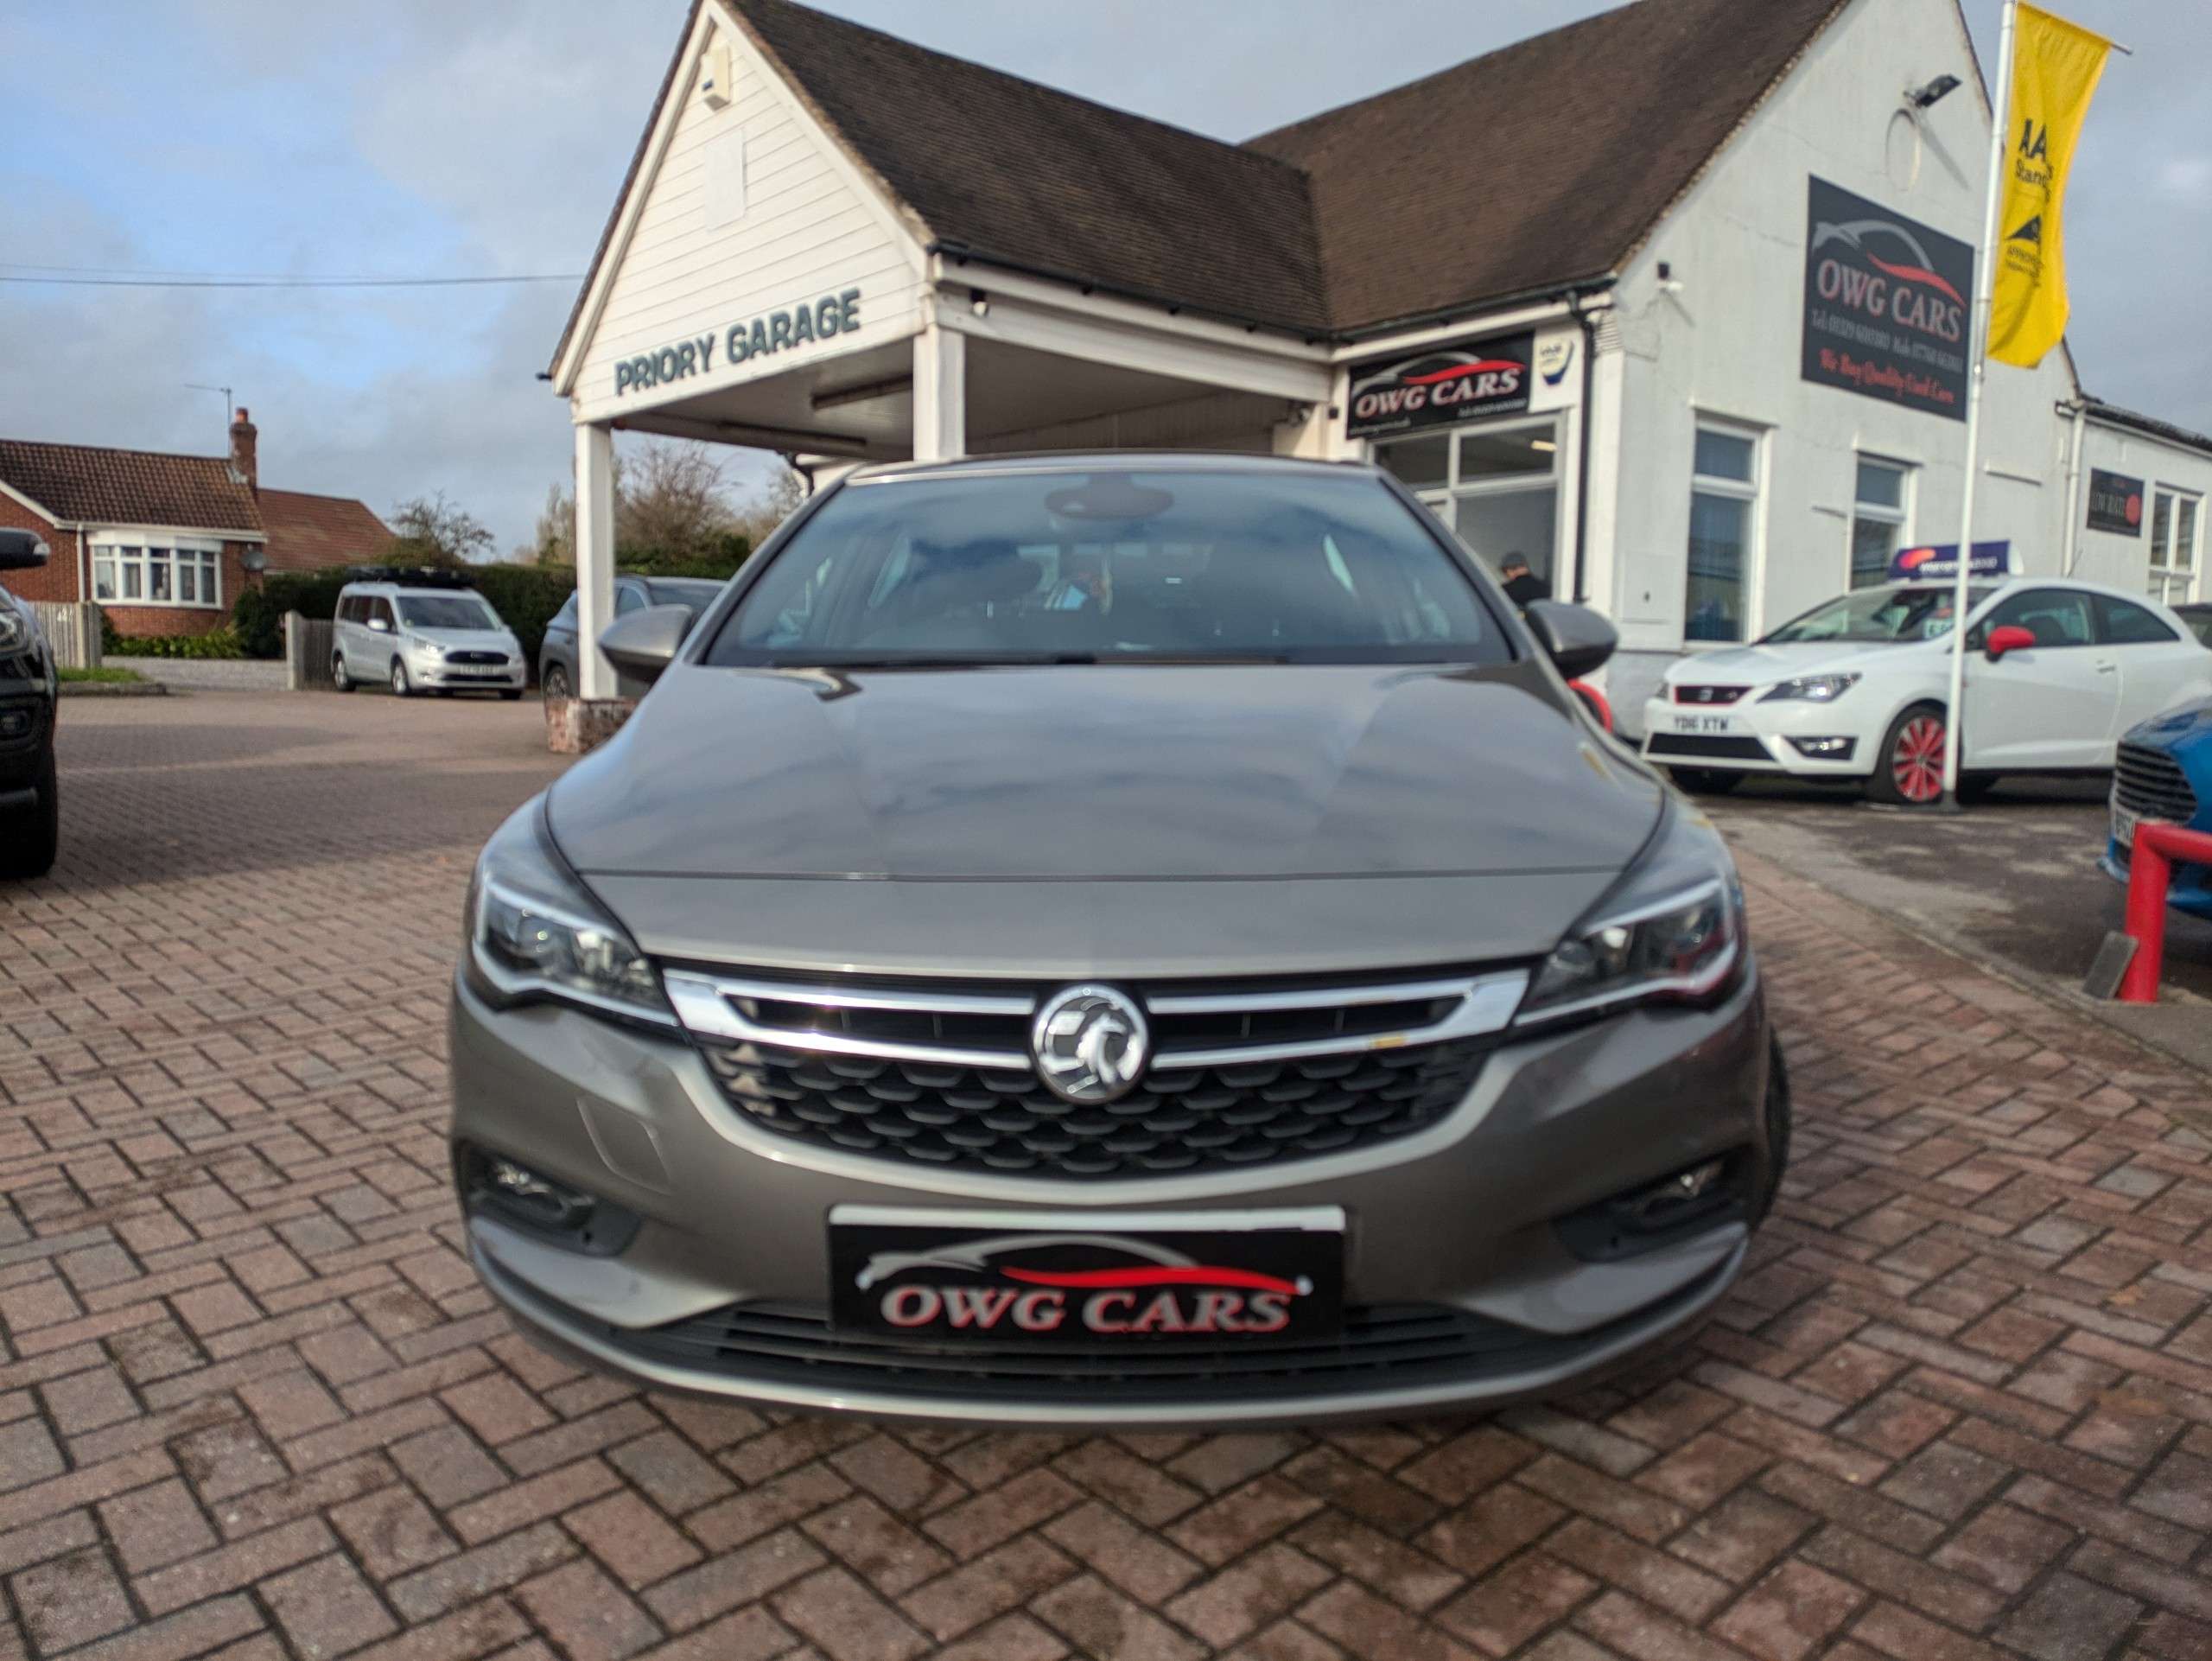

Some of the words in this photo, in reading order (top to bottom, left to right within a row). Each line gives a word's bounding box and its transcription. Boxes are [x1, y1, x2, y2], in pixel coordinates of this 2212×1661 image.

[2019, 118, 2047, 162] AA
[1817, 258, 1886, 316] OWG
[1892, 287, 1961, 342] CARS
[615, 332, 715, 396] PRIORY
[726, 288, 861, 363] GARAGE
[1355, 383, 1426, 418] OWG
[1431, 367, 1520, 405] CARS
[880, 1285, 1066, 1332] OWG
[1081, 1289, 1293, 1333] CARS
